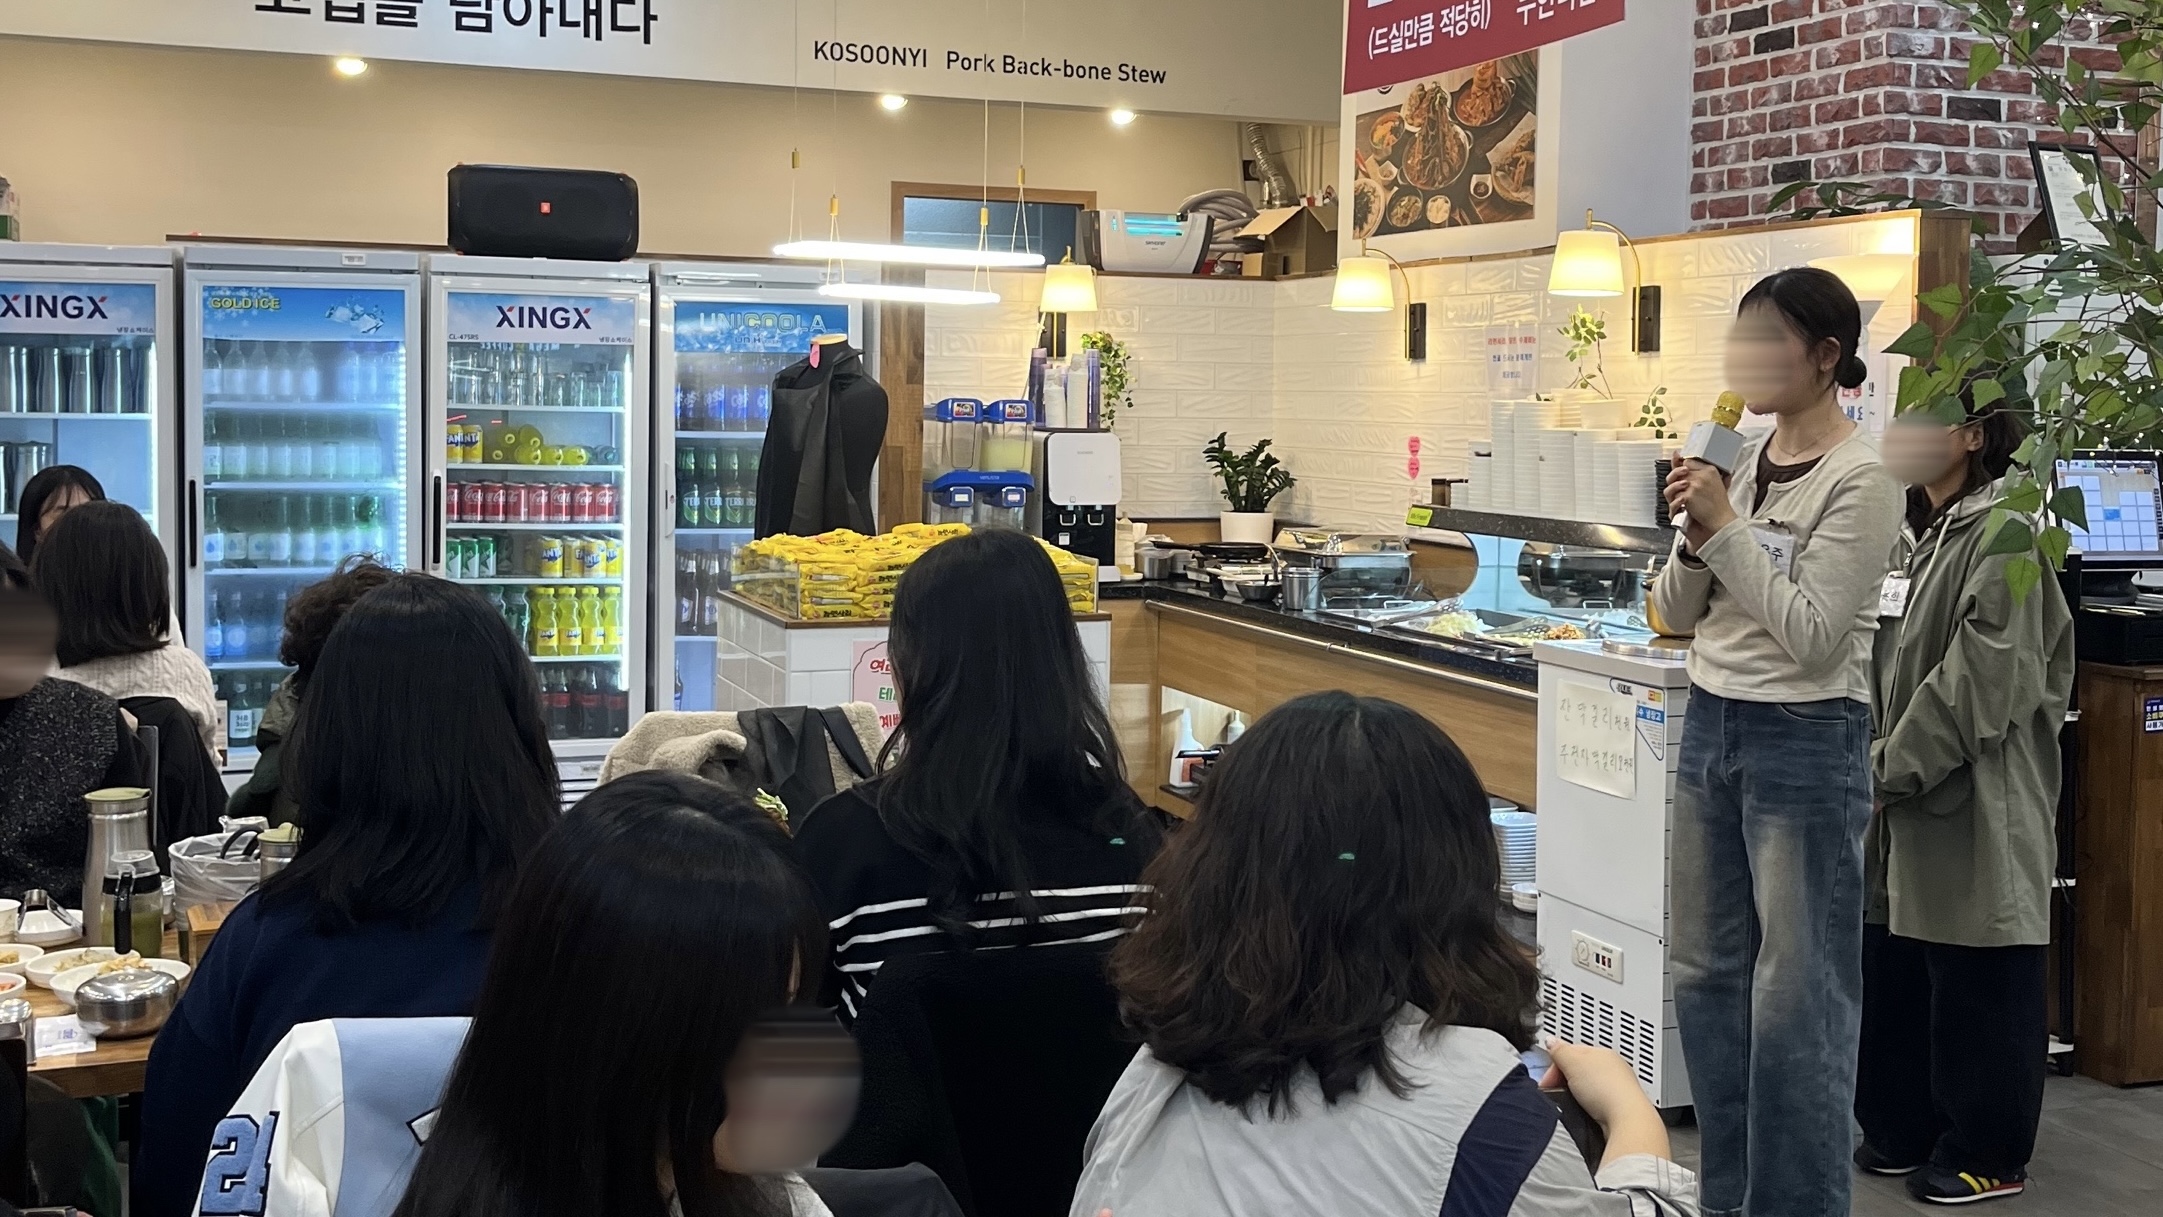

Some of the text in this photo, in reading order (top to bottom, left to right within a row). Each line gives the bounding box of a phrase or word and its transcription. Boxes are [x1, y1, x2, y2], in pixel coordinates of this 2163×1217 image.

[1368, 0, 1491, 60] (드실만큼 적당히)
[814, 40, 1167, 84] KOSOONYI Pork Back-bone Stew
[0, 294, 108, 319] XINGX
[495, 305, 592, 330] XINGX
[1560, 698, 1571, 722] 잔
[200, 1111, 281, 1217] 21
